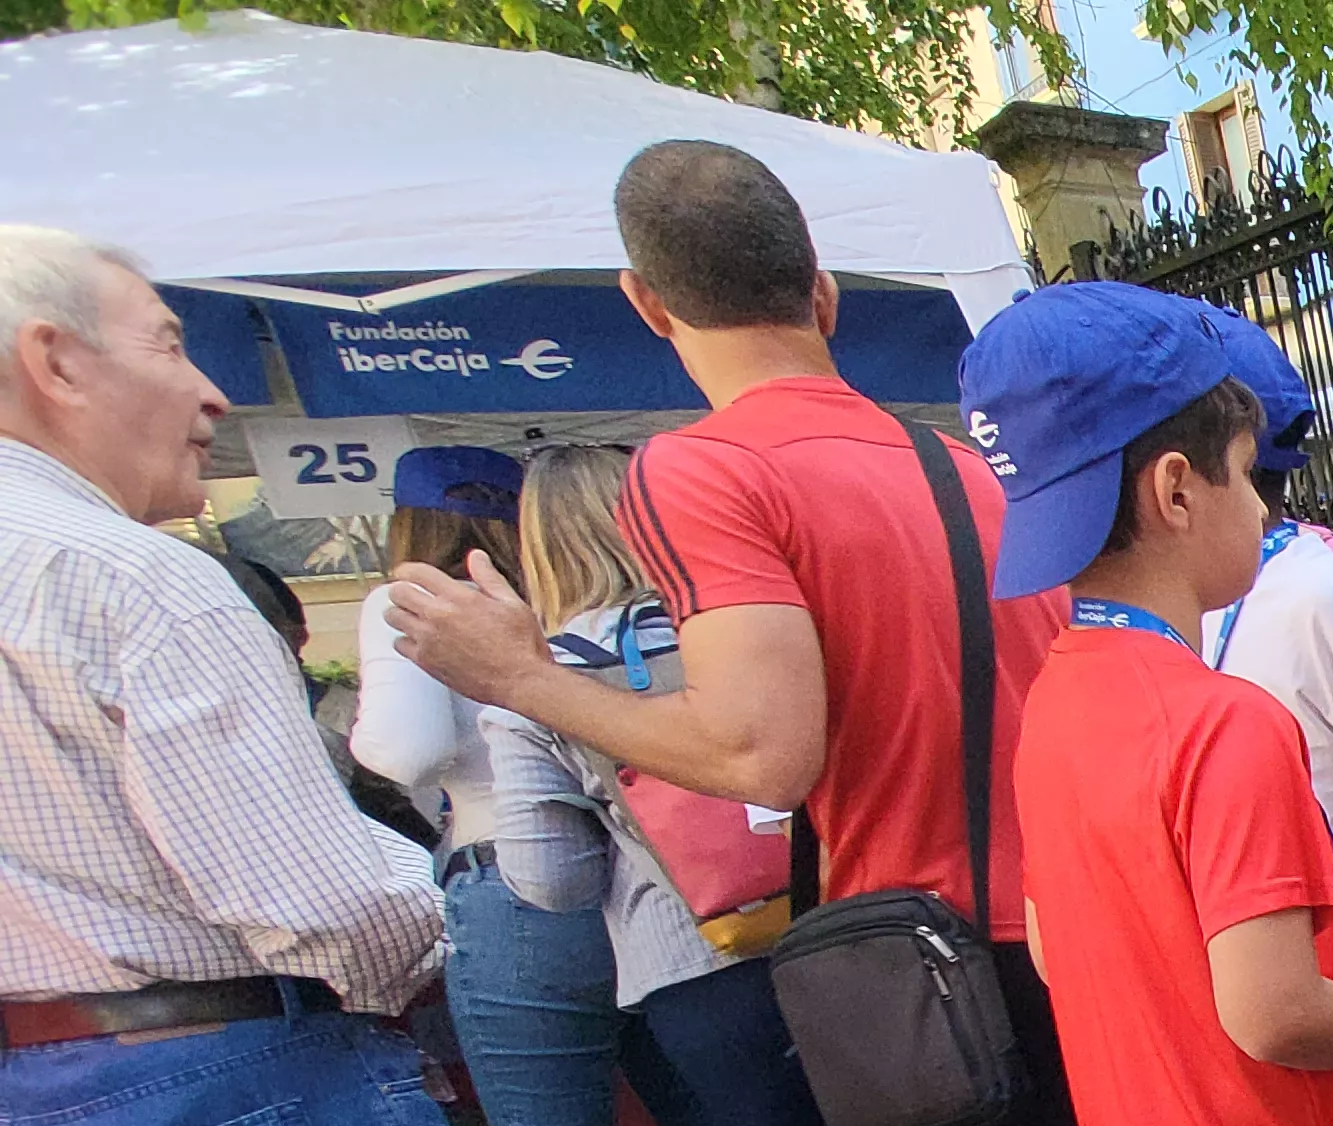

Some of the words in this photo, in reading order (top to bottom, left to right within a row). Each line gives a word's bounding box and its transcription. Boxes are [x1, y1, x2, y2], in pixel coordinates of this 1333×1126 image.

[328, 320, 471, 341] Fundación
[338, 347, 490, 376] iberCaja
[289, 443, 377, 484] 25
